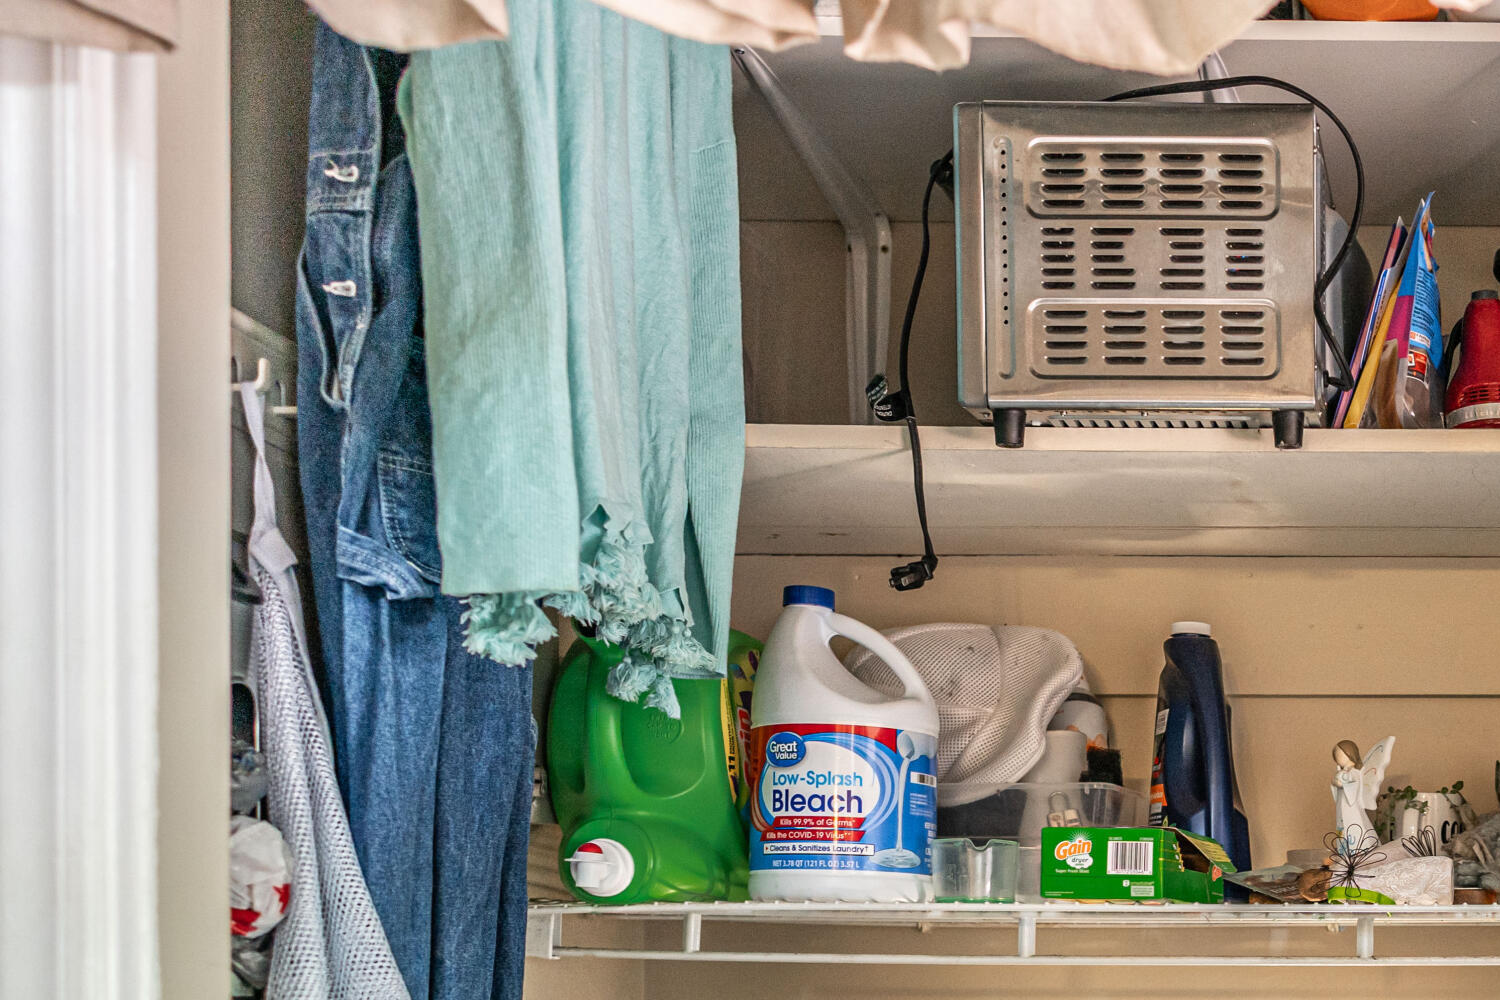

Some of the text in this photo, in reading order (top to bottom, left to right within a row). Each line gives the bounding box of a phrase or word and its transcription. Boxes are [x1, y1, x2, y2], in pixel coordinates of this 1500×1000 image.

[769, 741, 798, 753] Great
[775, 751, 798, 760] Value
[772, 771, 863, 788] Low-Splash
[772, 790, 863, 814] Bleach
[779, 818, 792, 826] Kills
[792, 818, 815, 826] 99.9%
[816, 818, 825, 826] of
[766, 831, 776, 839] Kills
[776, 831, 787, 839] the
[769, 844, 790, 852] Cleans
[791, 844, 797, 852] &
[798, 844, 830, 852] Sanitizes
[1055, 840, 1092, 860] Gain
[1071, 856, 1089, 864] dryer
